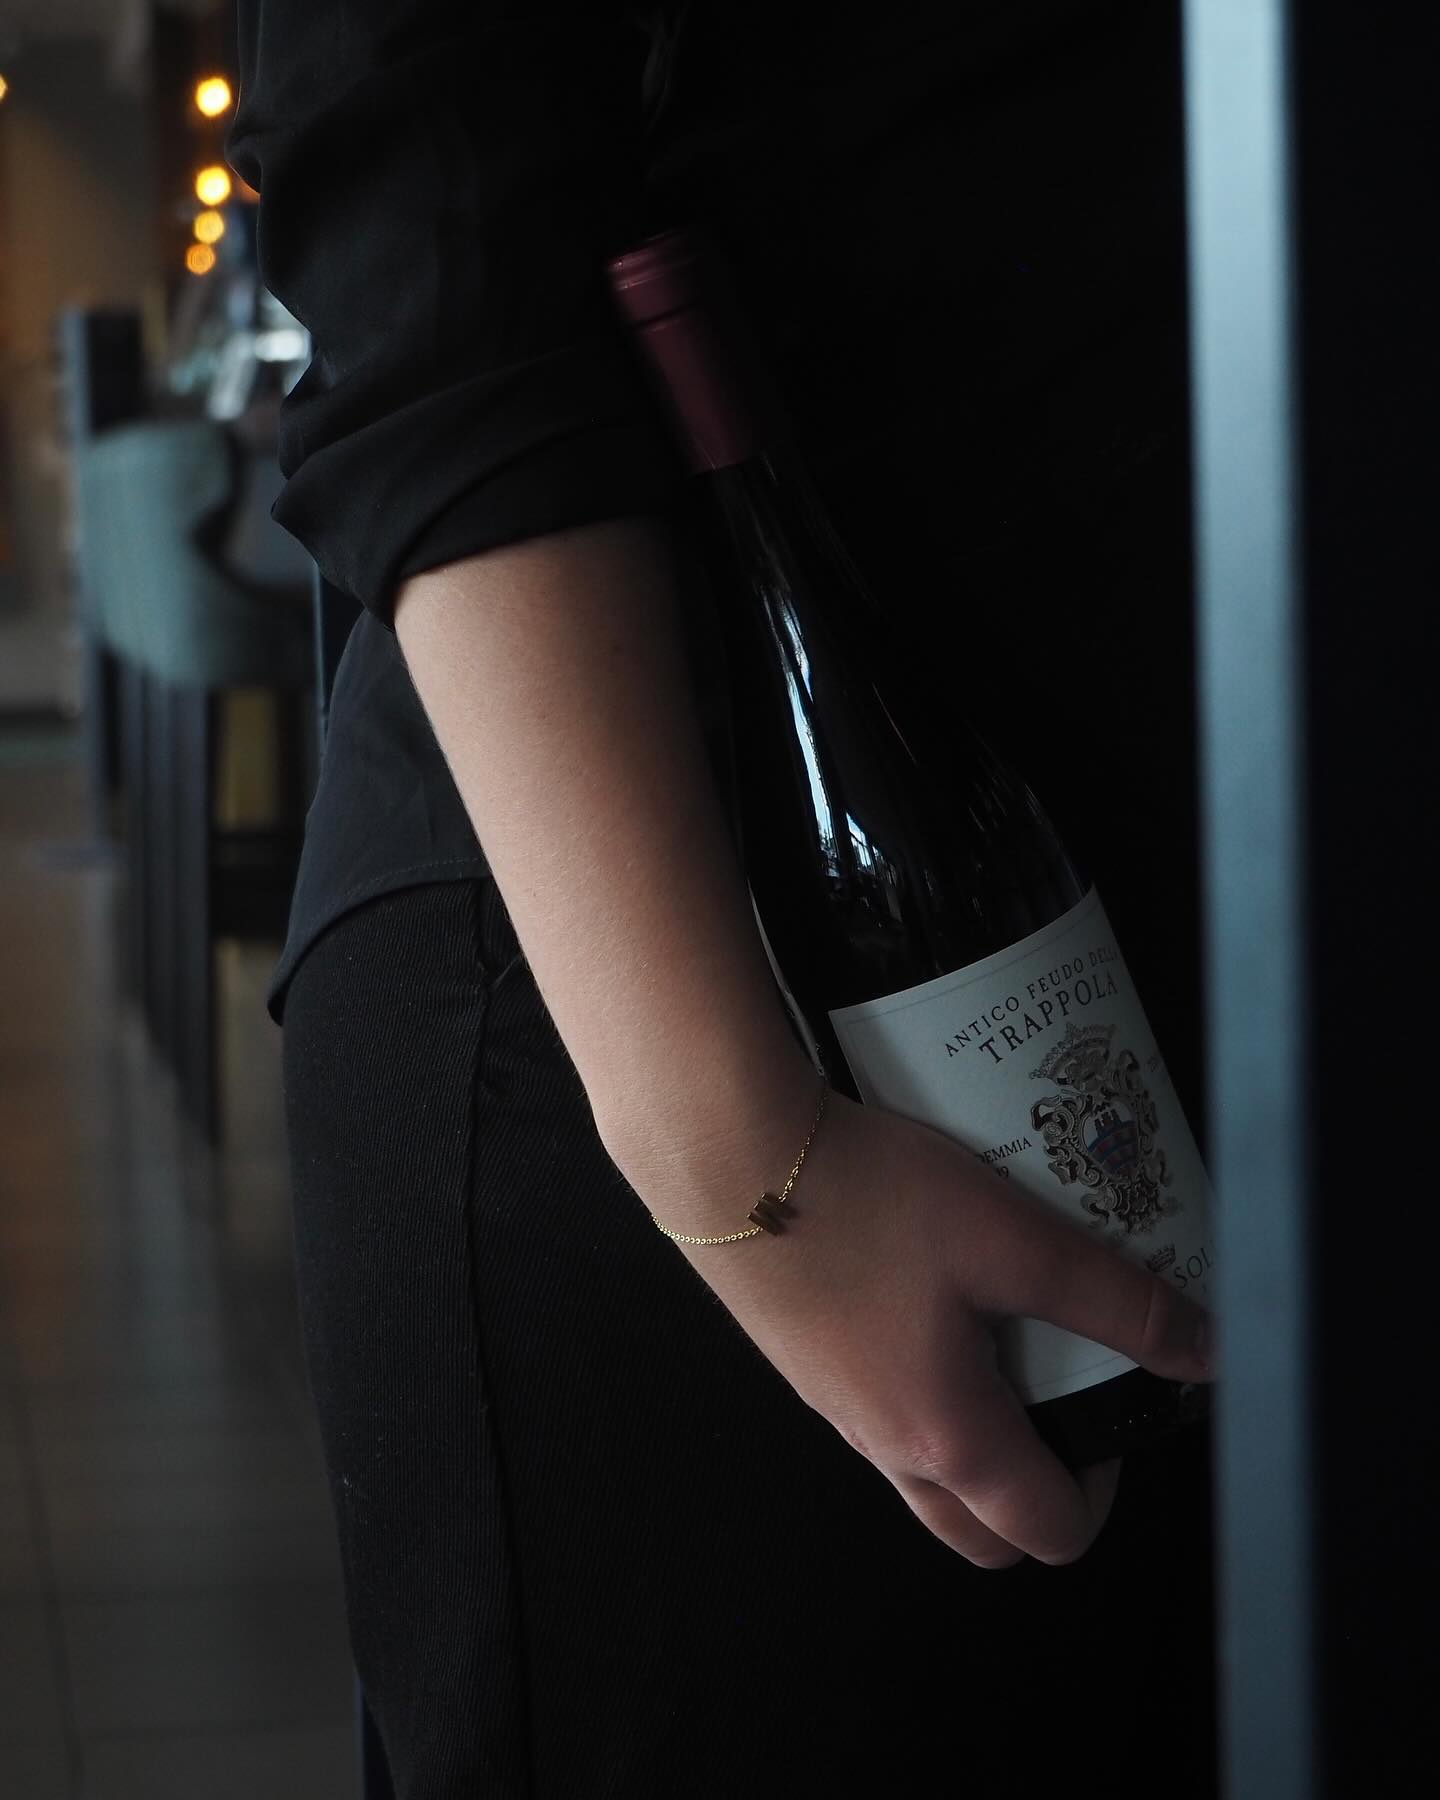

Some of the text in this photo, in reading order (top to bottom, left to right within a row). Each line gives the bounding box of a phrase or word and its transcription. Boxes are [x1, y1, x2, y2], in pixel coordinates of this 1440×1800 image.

[945, 996, 1019, 1057] ANTICO
[1026, 957, 1084, 999] FEUDO
[978, 968, 1118, 1063] TRAPPOLA
